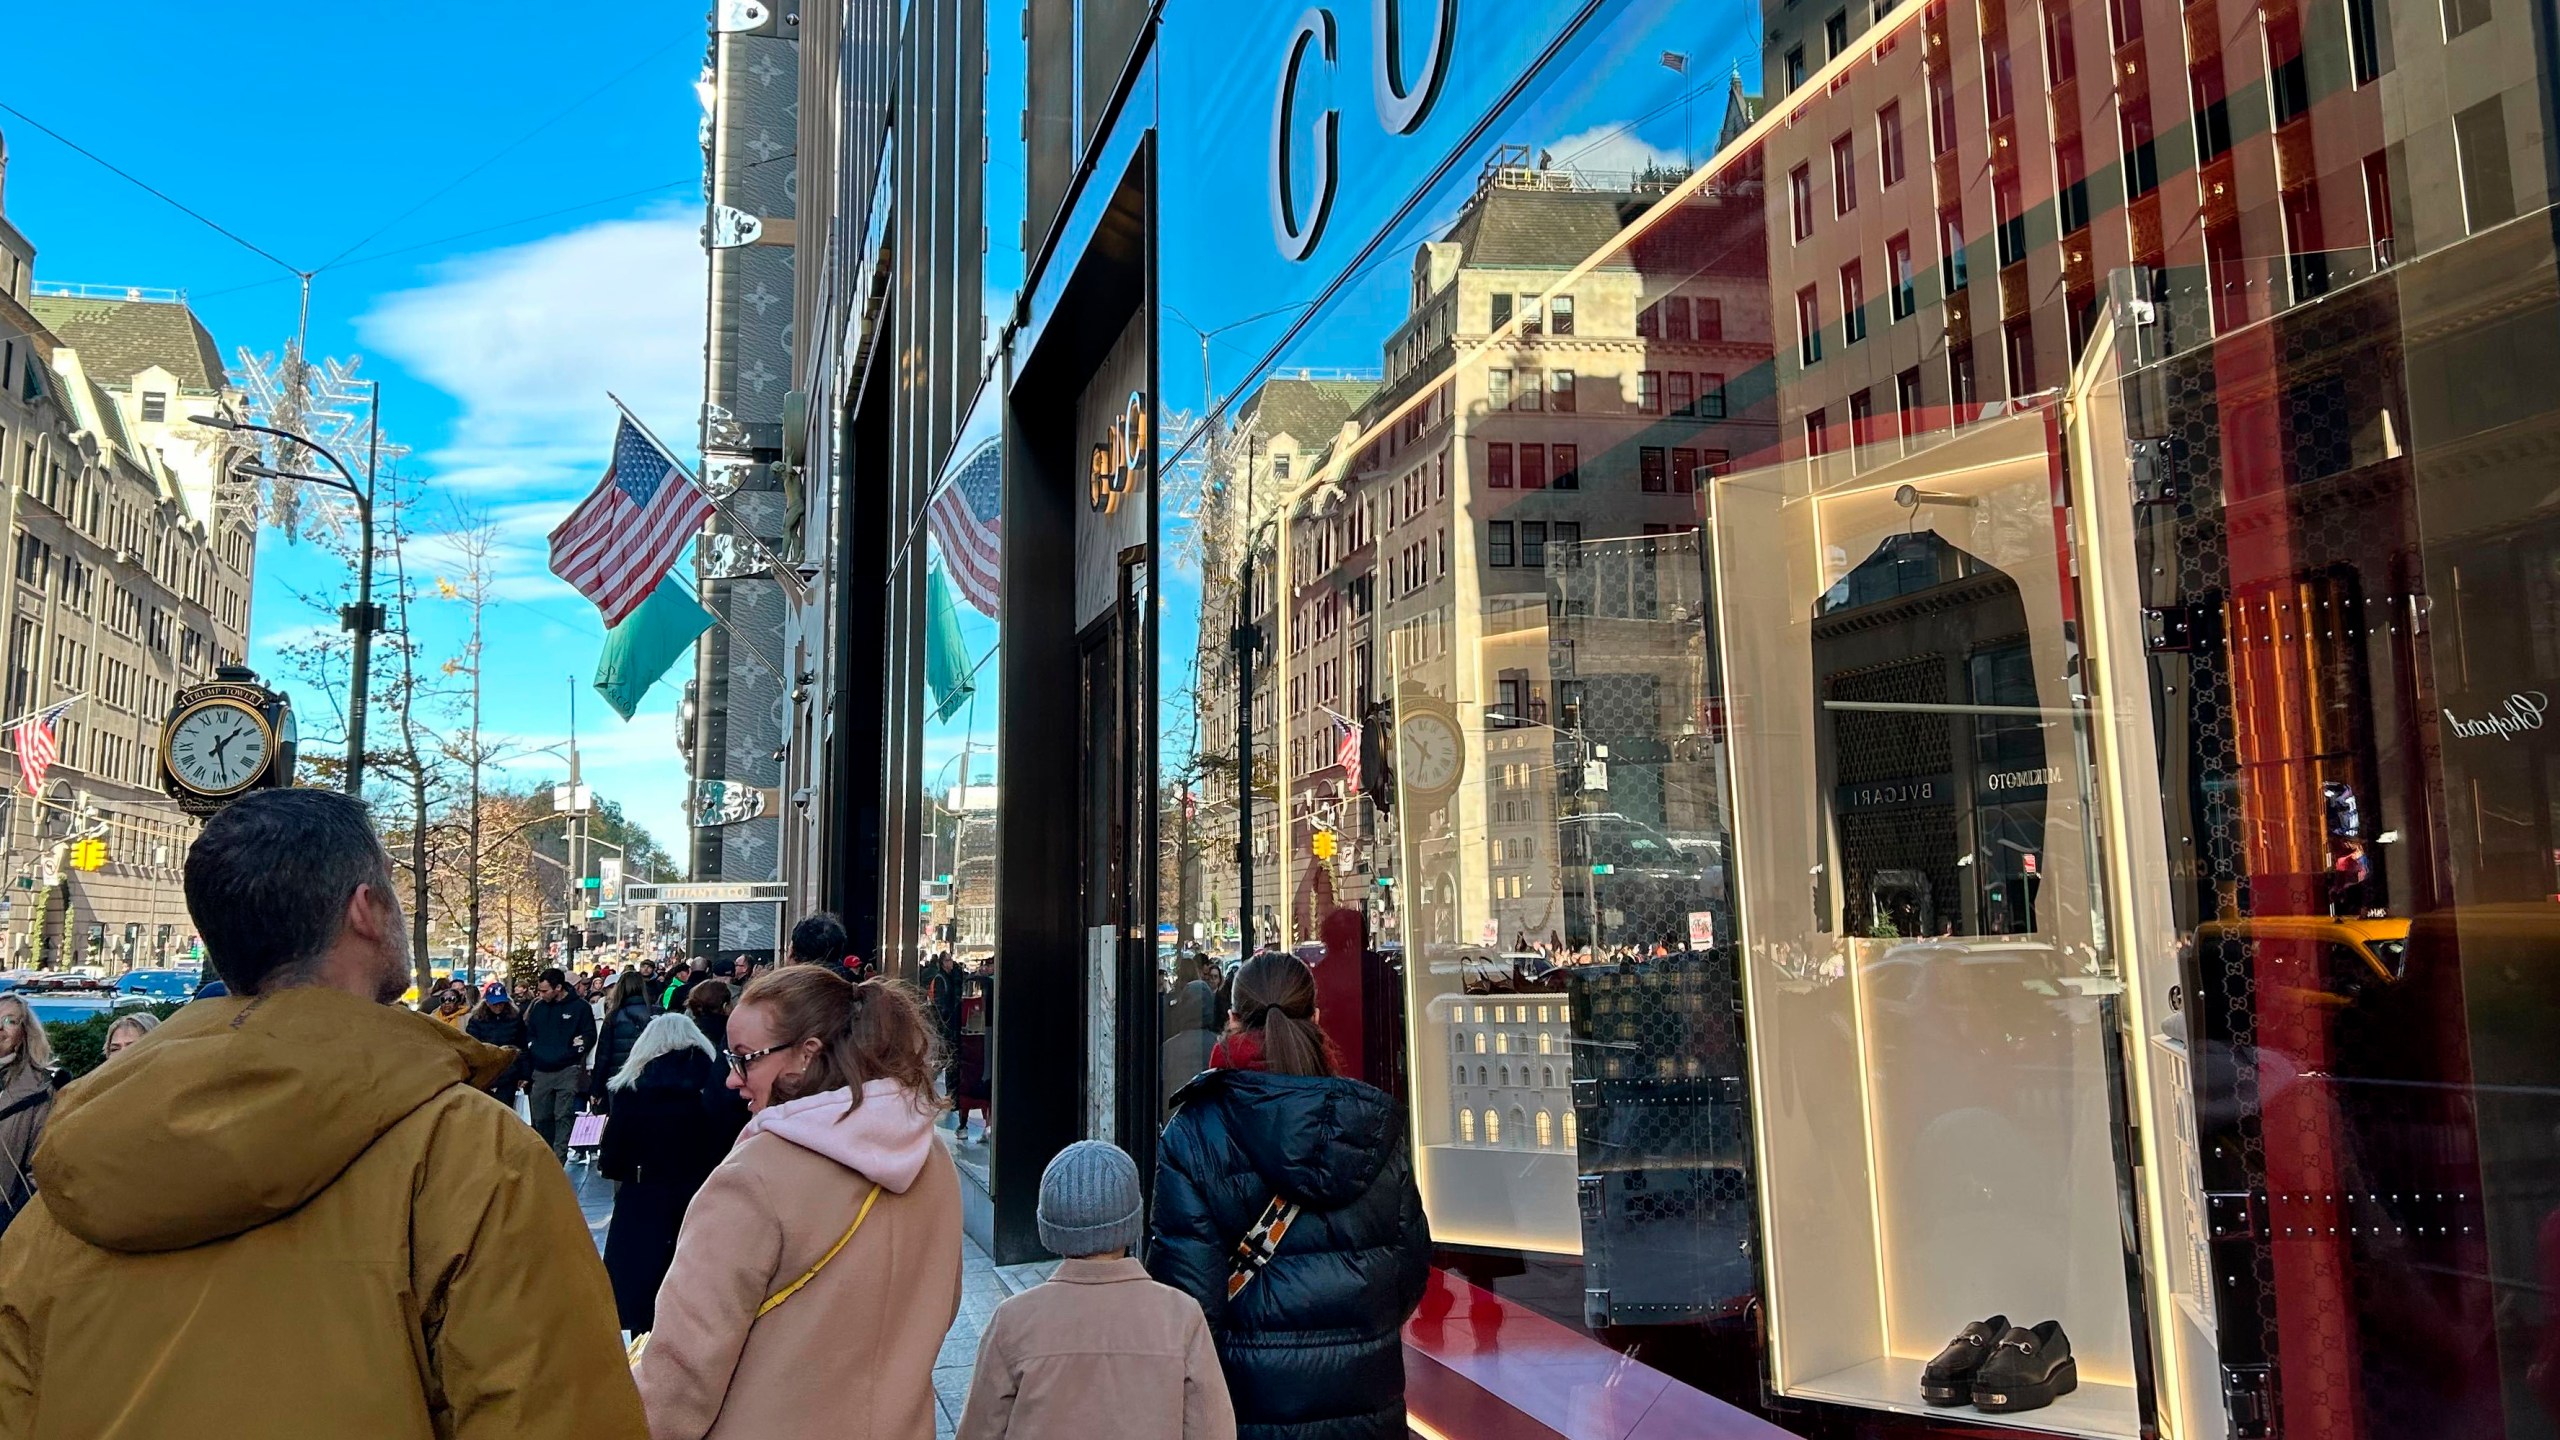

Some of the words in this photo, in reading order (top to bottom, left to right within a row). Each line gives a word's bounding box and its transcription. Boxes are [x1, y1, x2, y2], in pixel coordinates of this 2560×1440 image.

[188, 687, 222, 703] TRUMP
[224, 687, 256, 703] TOWER
[666, 887, 714, 899] TIFFANY
